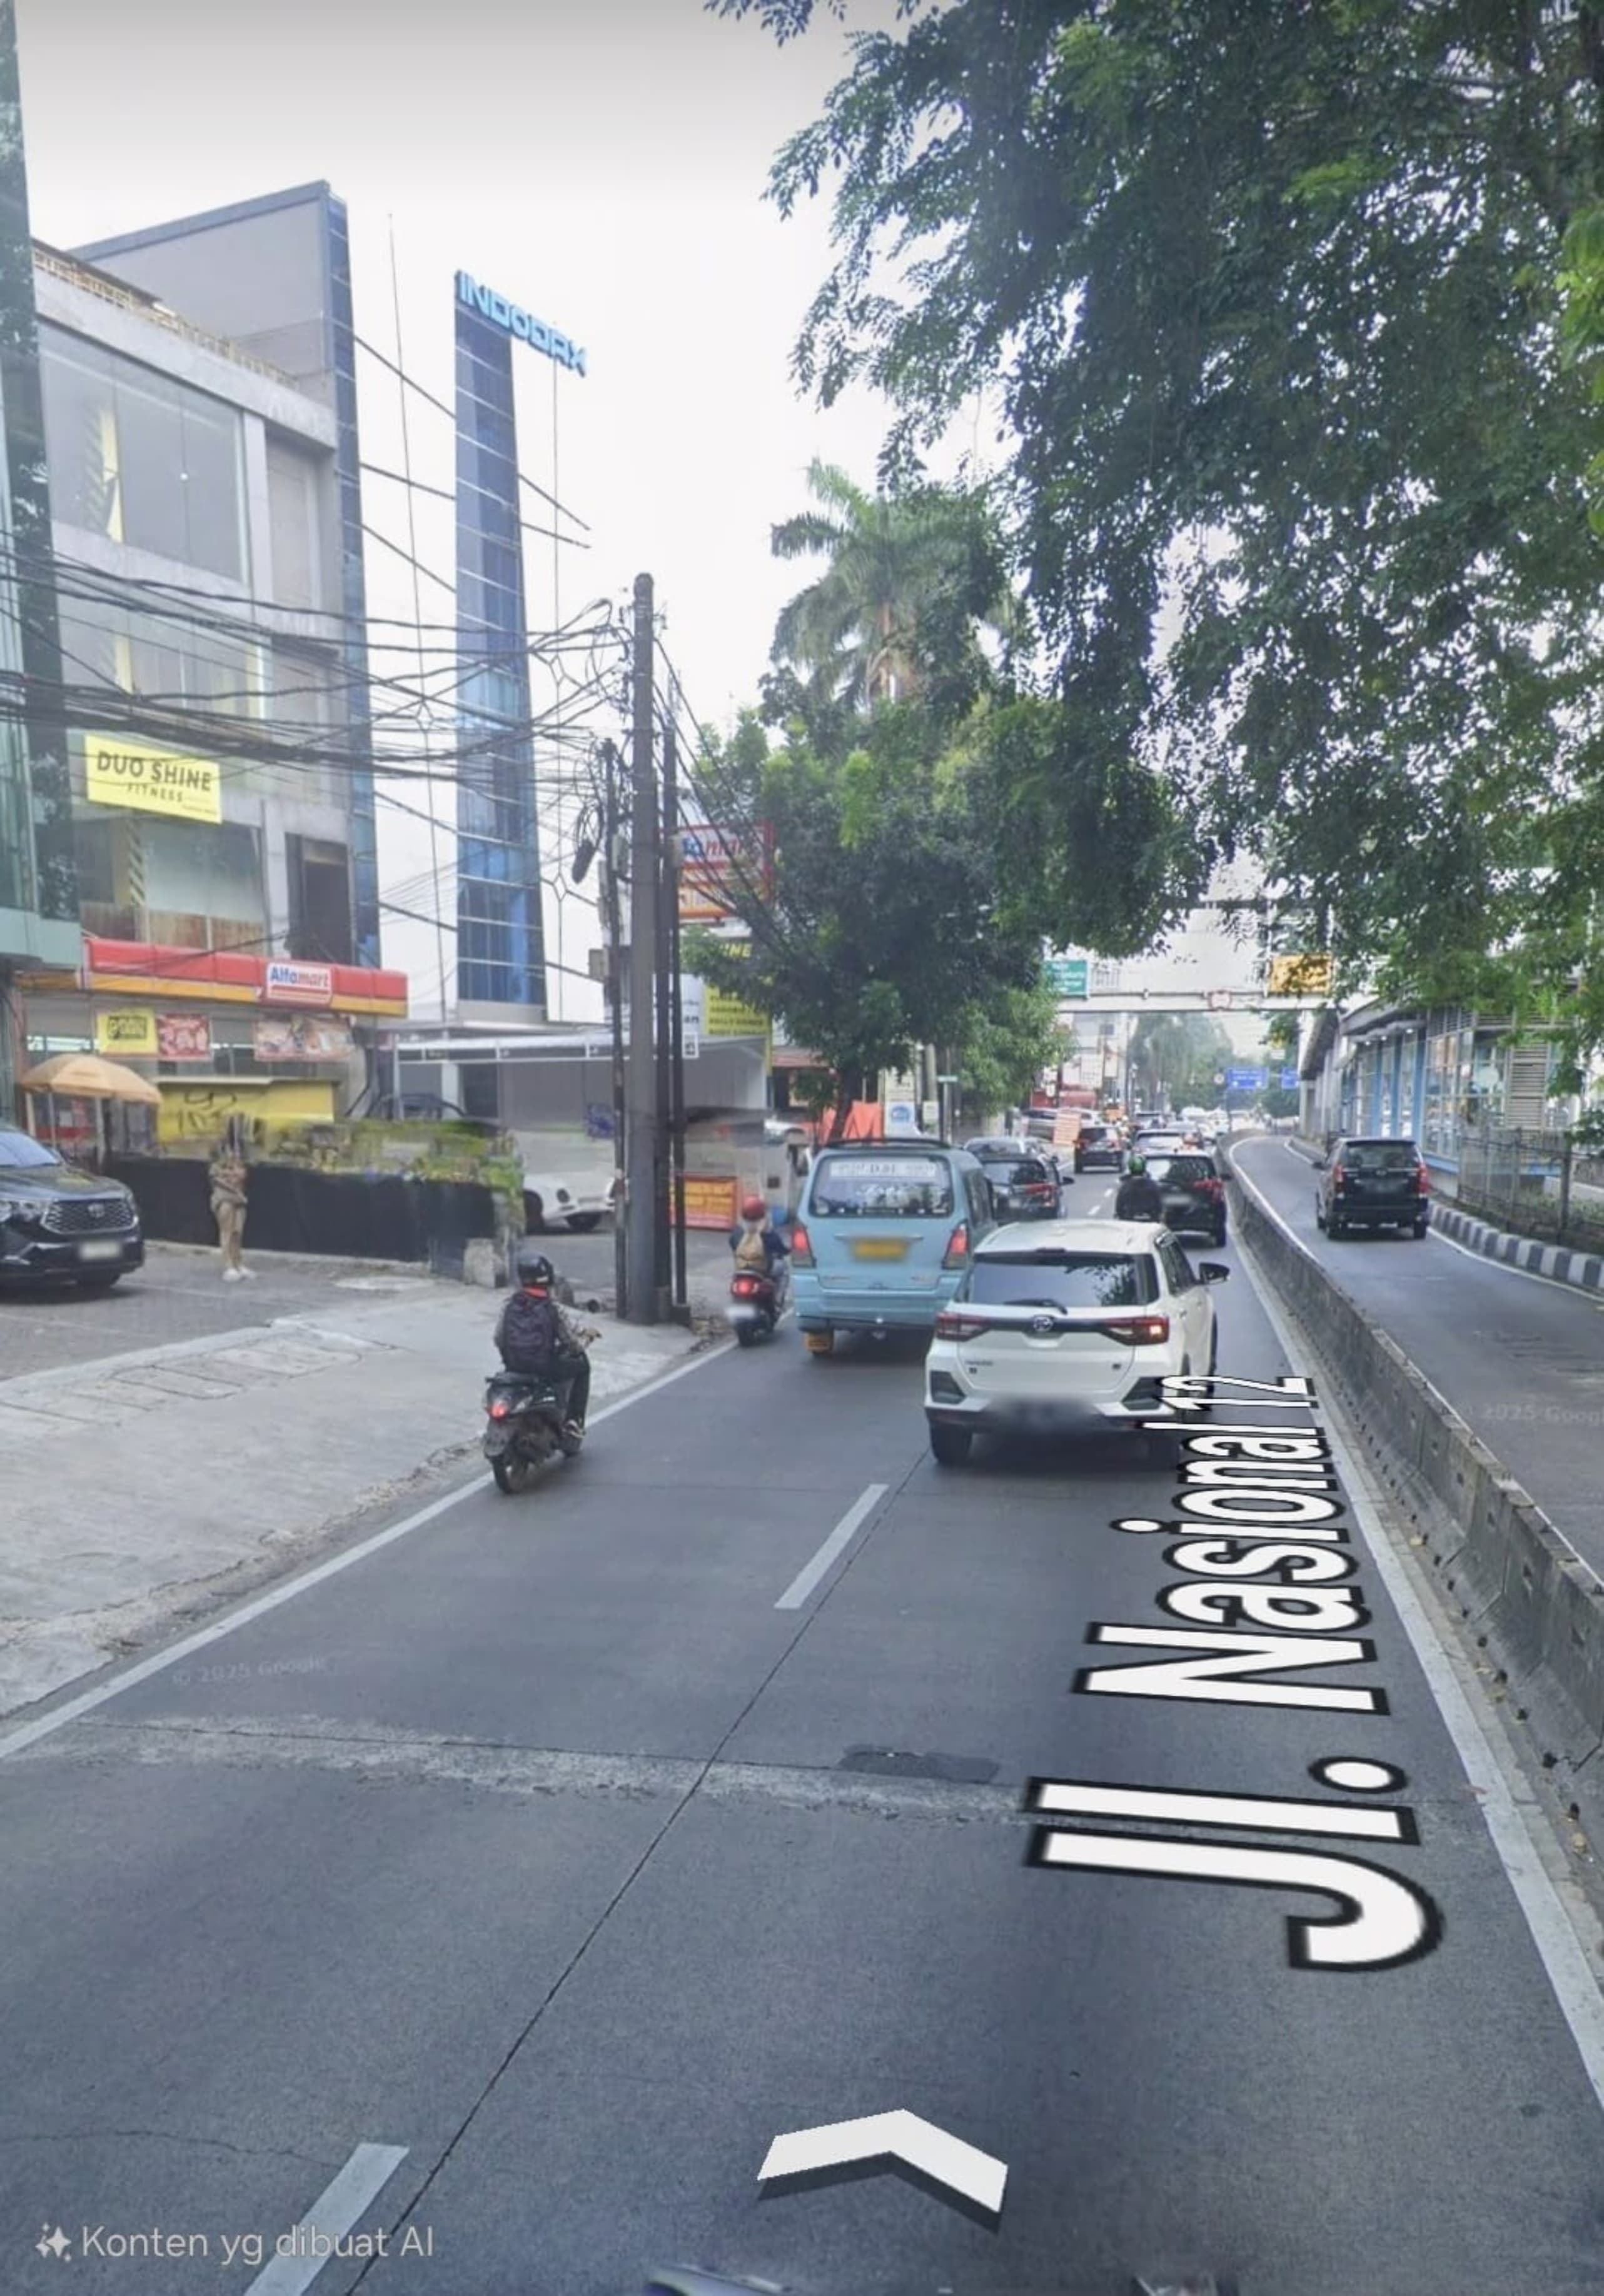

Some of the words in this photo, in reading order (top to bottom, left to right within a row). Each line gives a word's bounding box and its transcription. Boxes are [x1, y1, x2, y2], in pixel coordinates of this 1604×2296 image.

[454, 269, 588, 378] INDODAX
[97, 751, 144, 778] DUO
[151, 760, 212, 792] SHINE
[127, 782, 183, 802] FITNESS
[270, 965, 329, 988] Alfamart
